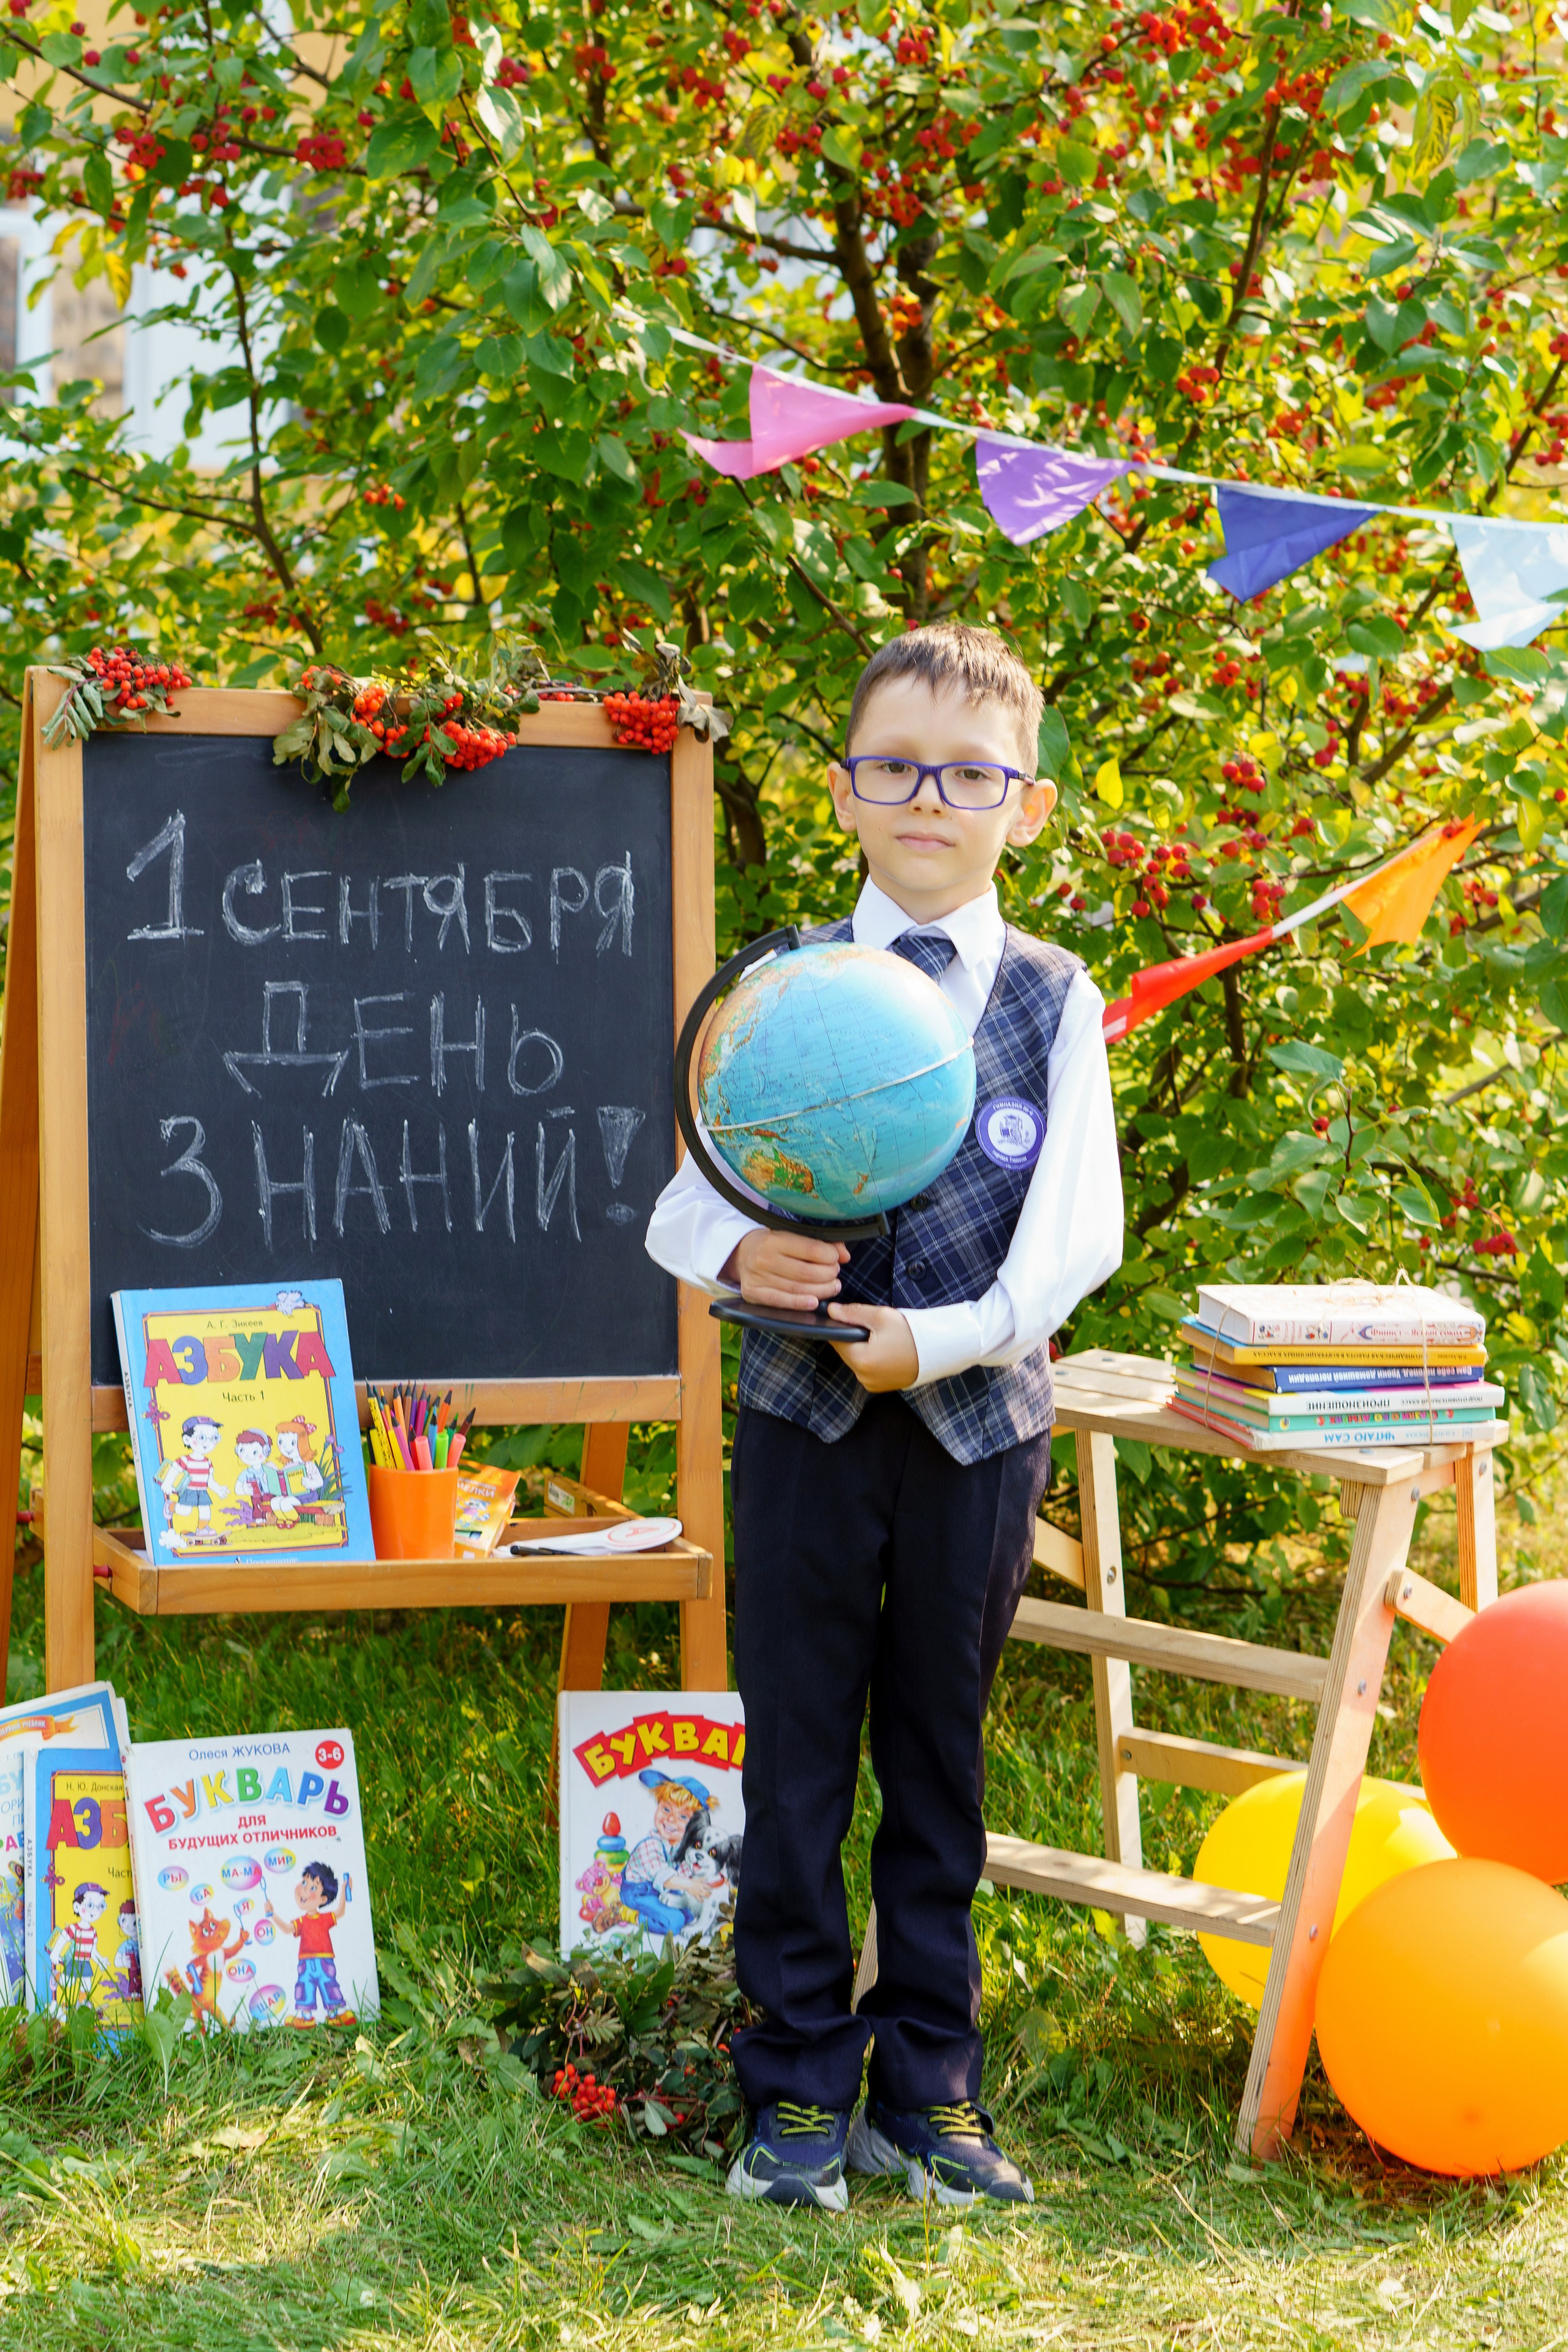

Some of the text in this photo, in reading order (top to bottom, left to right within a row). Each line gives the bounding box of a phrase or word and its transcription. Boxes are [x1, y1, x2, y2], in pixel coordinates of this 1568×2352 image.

[127, 810, 635, 963] 1 СЕНТЯБРЯ
[224, 981, 564, 1098] ДЕНЬ
[138, 1106, 646, 1250] ЗНАНИЙ!
[207, 1319, 263, 1330] А. Г. Зикеев
[143, 1330, 337, 1387] АЗБУКА
[1333, 1368, 1376, 1383] домашней
[1377, 1368, 1401, 1379] Уроки
[1456, 1365, 1472, 1376] Сам
[1288, 1372, 1332, 1384] логопедии
[124, 1371, 133, 1408] АЗБУКА
[222, 1390, 265, 1402] Часть 1
[1306, 1398, 1390, 1412] ПРОИЗНОШЕНИЕ
[1329, 1412, 1390, 1425] БОГАТЫРЯХ
[1391, 1411, 1400, 1421] О
[1324, 1431, 1395, 1444] ЧИТАЮ САМ
[22, 1719, 47, 1730] УЧЕБНИК
[189, 1743, 290, 1761] Олеся ЖУКОВА
[318, 1747, 342, 1762] 3-6
[66, 1781, 123, 1793] Н. Ю. Донская
[144, 1767, 349, 1833] БУКВАРЬ
[45, 1796, 130, 1850] АЗБ
[238, 1815, 266, 1829] ДЛЯ
[168, 1825, 337, 1850] БУДУЩИХ ОТЛИЧНИКОВ
[268, 1855, 293, 1866] МИР
[222, 1865, 262, 1878] МА-МА
[163, 1874, 183, 1883] РЫ
[194, 1888, 211, 1902] БА
[241, 1901, 250, 1911] Я
[256, 1926, 273, 1937] ОН
[228, 1964, 254, 1977] ОНА
